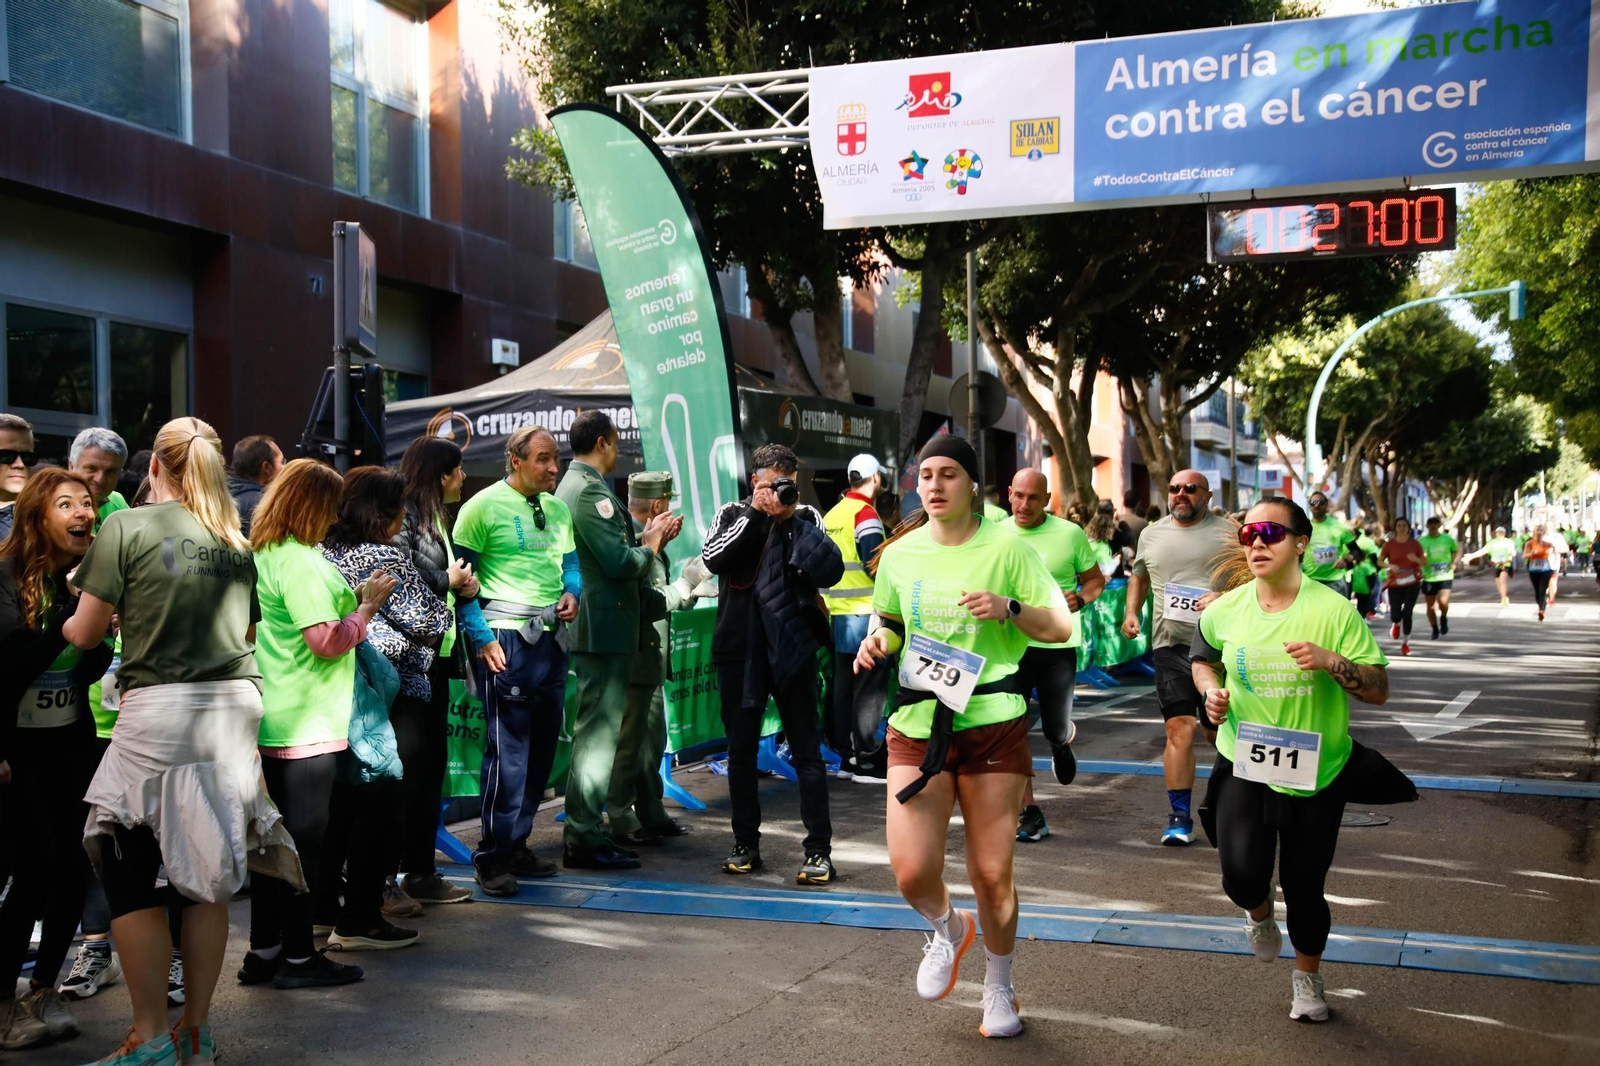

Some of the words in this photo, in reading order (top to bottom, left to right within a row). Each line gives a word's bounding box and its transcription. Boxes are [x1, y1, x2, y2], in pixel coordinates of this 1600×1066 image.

[1105, 43, 1277, 92] Almería
[1293, 41, 1348, 71] en
[1366, 16, 1554, 65] marcha
[1105, 100, 1247, 140] contra
[1262, 88, 1305, 125] el
[1318, 78, 1487, 120] cáncer
[1016, 121, 1054, 138] SOLAN
[1463, 126, 1521, 140] asociación
[1523, 122, 1571, 136] española
[1016, 138, 1025, 147] DE
[1027, 136, 1054, 146] CABRAS
[1465, 138, 1499, 151] contra
[1500, 136, 1510, 148] el
[1512, 135, 1549, 147] cáncer
[1465, 153, 1479, 162] en
[1481, 149, 1524, 161] Almería
[822, 160, 879, 178] ALMERÍA
[1093, 167, 1236, 187] #TodosContraElCáncer
[836, 178, 866, 187] CIUDAD
[186, 565, 231, 578] RUNNING
[911, 580, 924, 630] ALMERÍA
[923, 606, 967, 618] contra
[924, 619, 983, 635] cáncer
[915, 656, 961, 687] 759
[1235, 646, 1253, 693] ALMERÍA
[1248, 660, 1264, 670] En
[1250, 671, 1297, 682] contra
[1301, 669, 1315, 681] el
[1254, 683, 1315, 698] cáncer
[1250, 743, 1299, 769] 511
